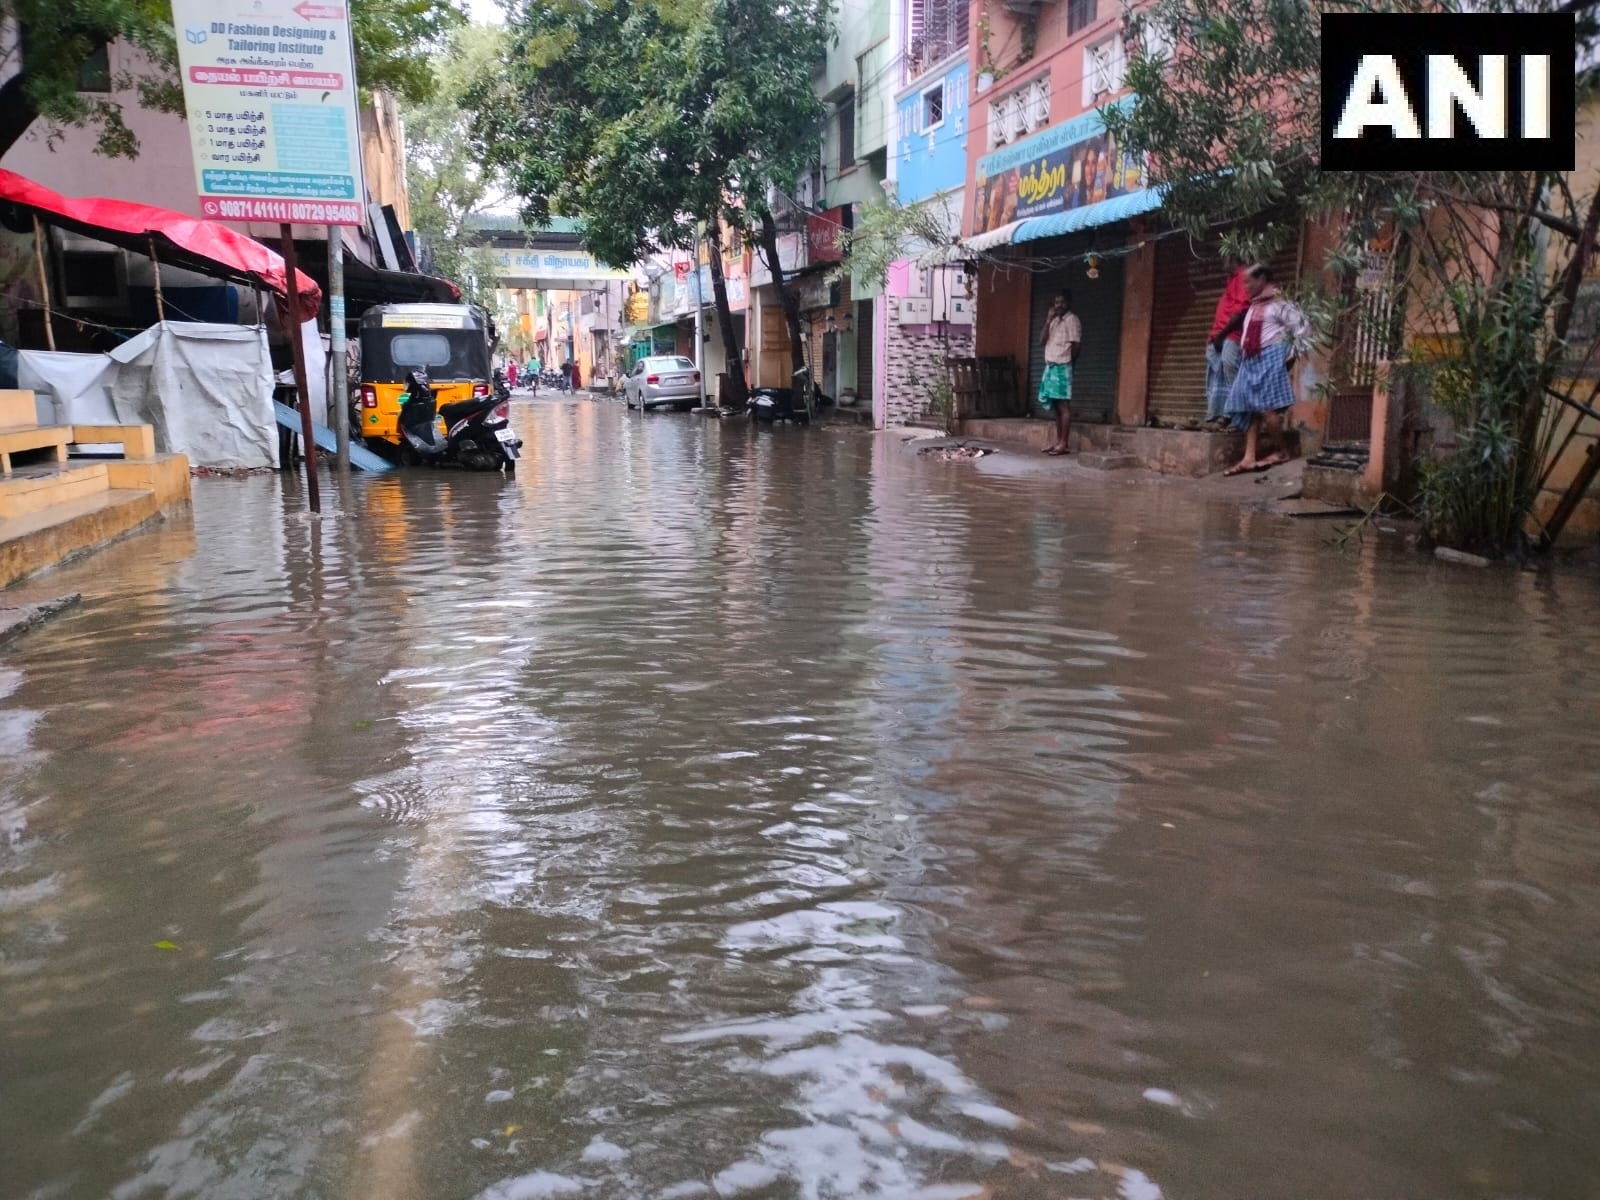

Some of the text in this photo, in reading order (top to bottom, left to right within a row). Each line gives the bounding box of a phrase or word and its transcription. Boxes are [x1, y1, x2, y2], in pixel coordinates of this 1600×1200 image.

[228, 23, 270, 37] Fashion
[273, 25, 327, 41] Designing
[329, 30, 337, 40] &
[228, 38, 324, 55] Tailoring Institute
[205, 110, 211, 119] 5
[235, 110, 265, 123] பயிற்சி
[207, 124, 214, 133] 3
[237, 124, 267, 137] பயிற்சி
[236, 138, 265, 151] பயிற்சி
[231, 152, 261, 164] பயிற்சி
[1019, 159, 1065, 205] மந்த்ரா
[219, 200, 253, 218] 90871
[254, 201, 285, 219] 41111
